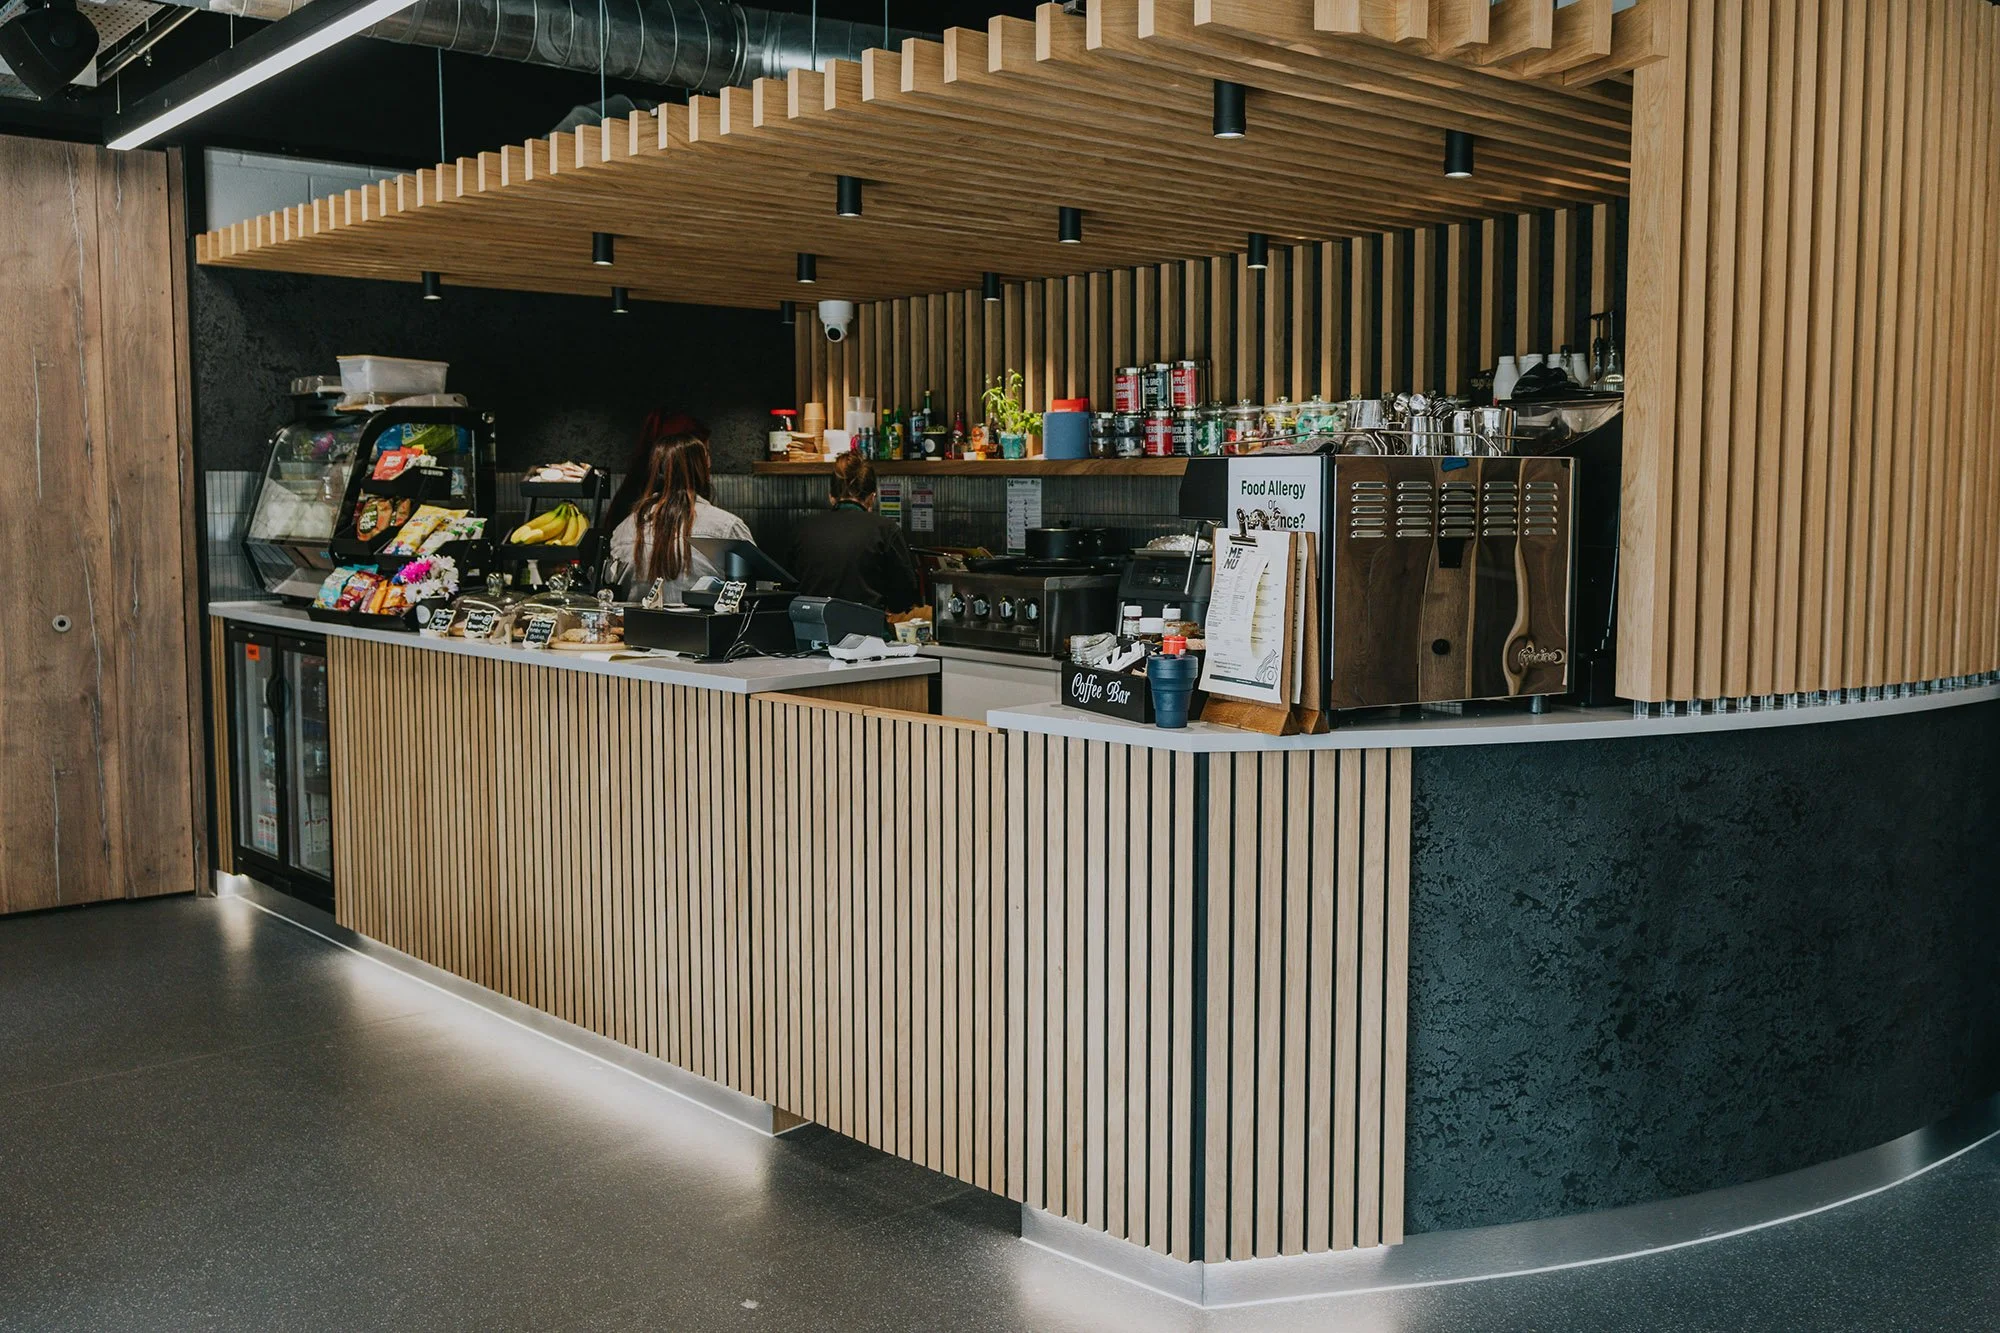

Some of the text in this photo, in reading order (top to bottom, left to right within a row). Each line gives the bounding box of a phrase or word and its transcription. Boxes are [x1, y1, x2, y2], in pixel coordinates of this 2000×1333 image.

[1241, 480, 1306, 500] Food Allergy
[1267, 500, 1277, 510] or
[1228, 546, 1244, 559] ME
[1223, 558, 1240, 570] NU
[1071, 672, 1131, 705] Coffee Bar
